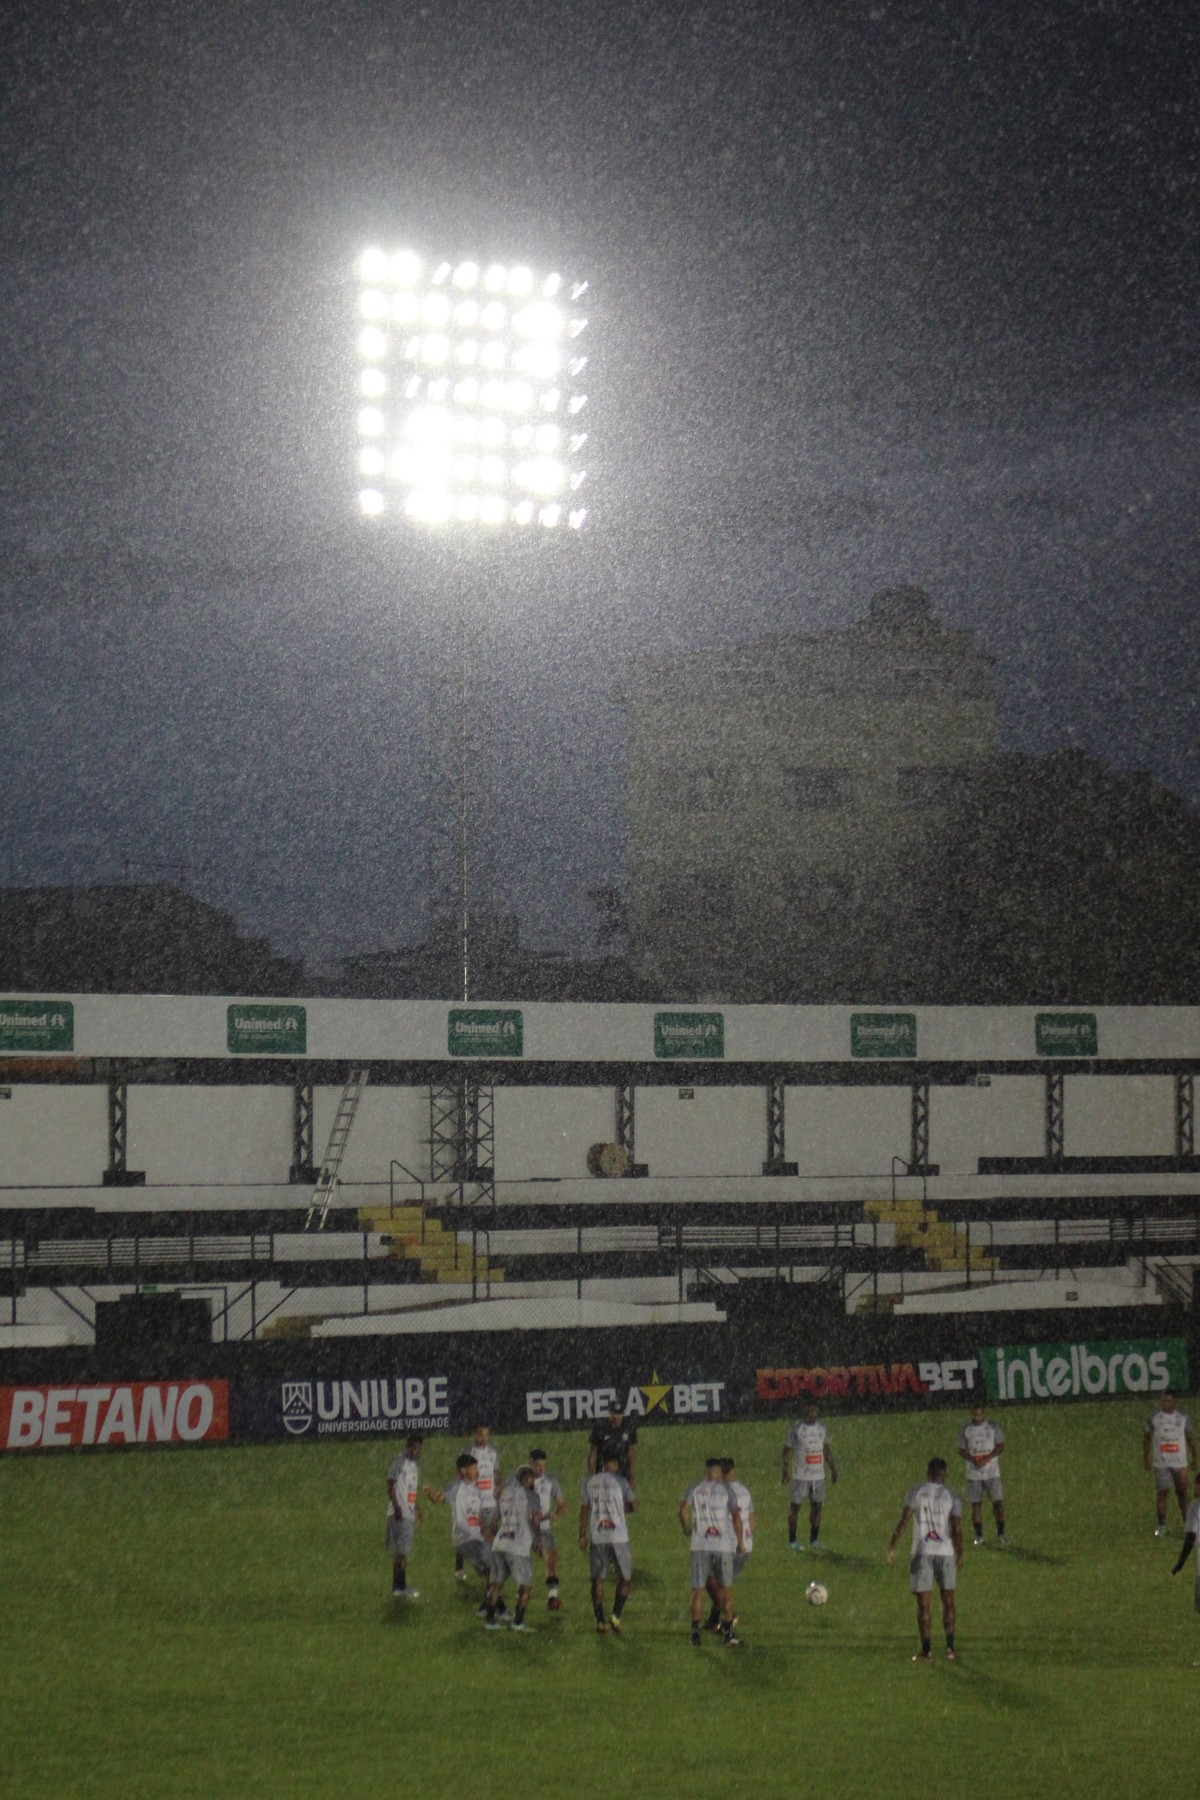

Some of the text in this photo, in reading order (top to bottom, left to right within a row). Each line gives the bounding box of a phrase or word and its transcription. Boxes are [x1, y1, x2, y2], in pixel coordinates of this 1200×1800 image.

[234, 1017, 282, 1030] Unimed
[455, 1020, 500, 1033] Unimed
[661, 1024, 702, 1036] Unimed
[996, 1344, 1170, 1400] intelbras
[316, 1377, 449, 1421] UNIUBE
[6, 1383, 214, 1448] BETANO
[318, 1416, 449, 1434] UNIVERSIDADE DE VERDADE
